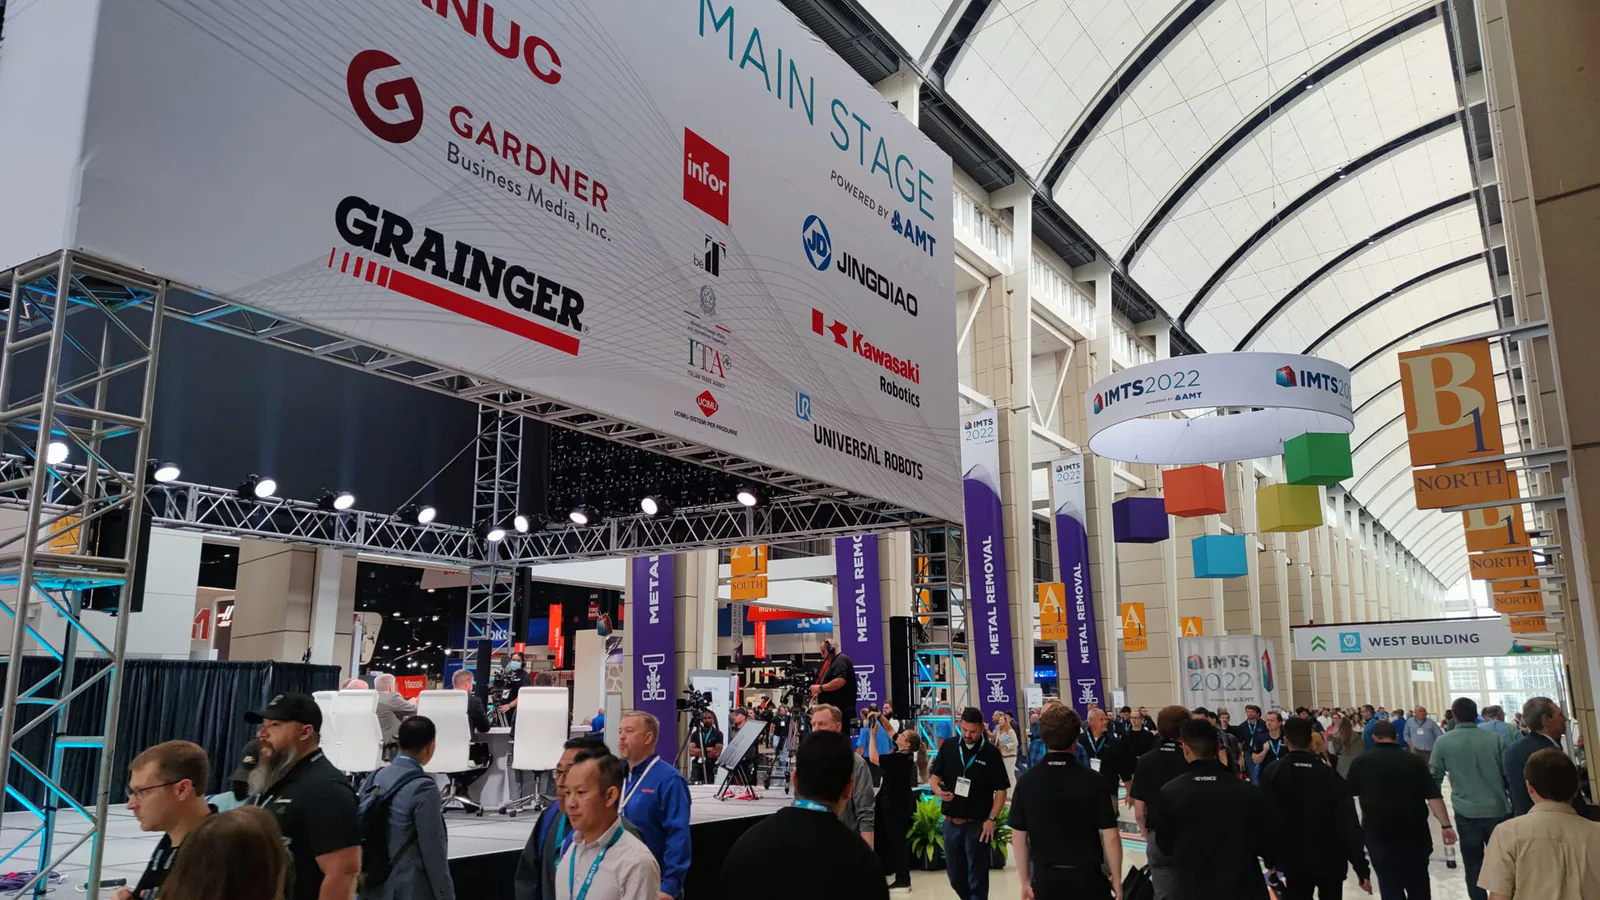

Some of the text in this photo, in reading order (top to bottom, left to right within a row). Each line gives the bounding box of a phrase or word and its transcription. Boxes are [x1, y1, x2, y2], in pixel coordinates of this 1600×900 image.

[421, 0, 562, 84] NUC
[699, 0, 935, 222] MAIN STAGE
[449, 105, 609, 213] GARDNER
[687, 152, 727, 196] infor
[447, 140, 612, 242] Business Media, Inc.
[830, 169, 936, 257] POWERED BY AMT
[335, 195, 585, 331] GRAINGER
[837, 251, 918, 317] JINGDIAO
[852, 330, 920, 384] Kawasaki
[880, 375, 920, 408] Robotics
[1181, 391, 1202, 401] AMT
[965, 427, 994, 441] 2022
[973, 418, 994, 429] IMTS
[813, 424, 923, 481] UNIVERSAL ROBOTS
[1063, 462, 1081, 471] IMTS
[1057, 470, 1080, 482] 2022
[1417, 469, 1504, 492] NORTH
[1472, 555, 1528, 570] NORTH
[732, 580, 763, 591] SOUTH
[852, 535, 868, 642] METAL REMO
[982, 535, 1000, 655] METAL REMOVAL
[1073, 562, 1090, 664] METAL REMOVAL
[1496, 595, 1538, 605] NORTH
[1041, 626, 1065, 635] SOUTH
[1511, 618, 1545, 627] NORTH
[1368, 635, 1407, 647] WEST
[1411, 633, 1480, 646] BUILDING
[1207, 654, 1251, 669] IMTS
[1190, 672, 1253, 692] 2022
